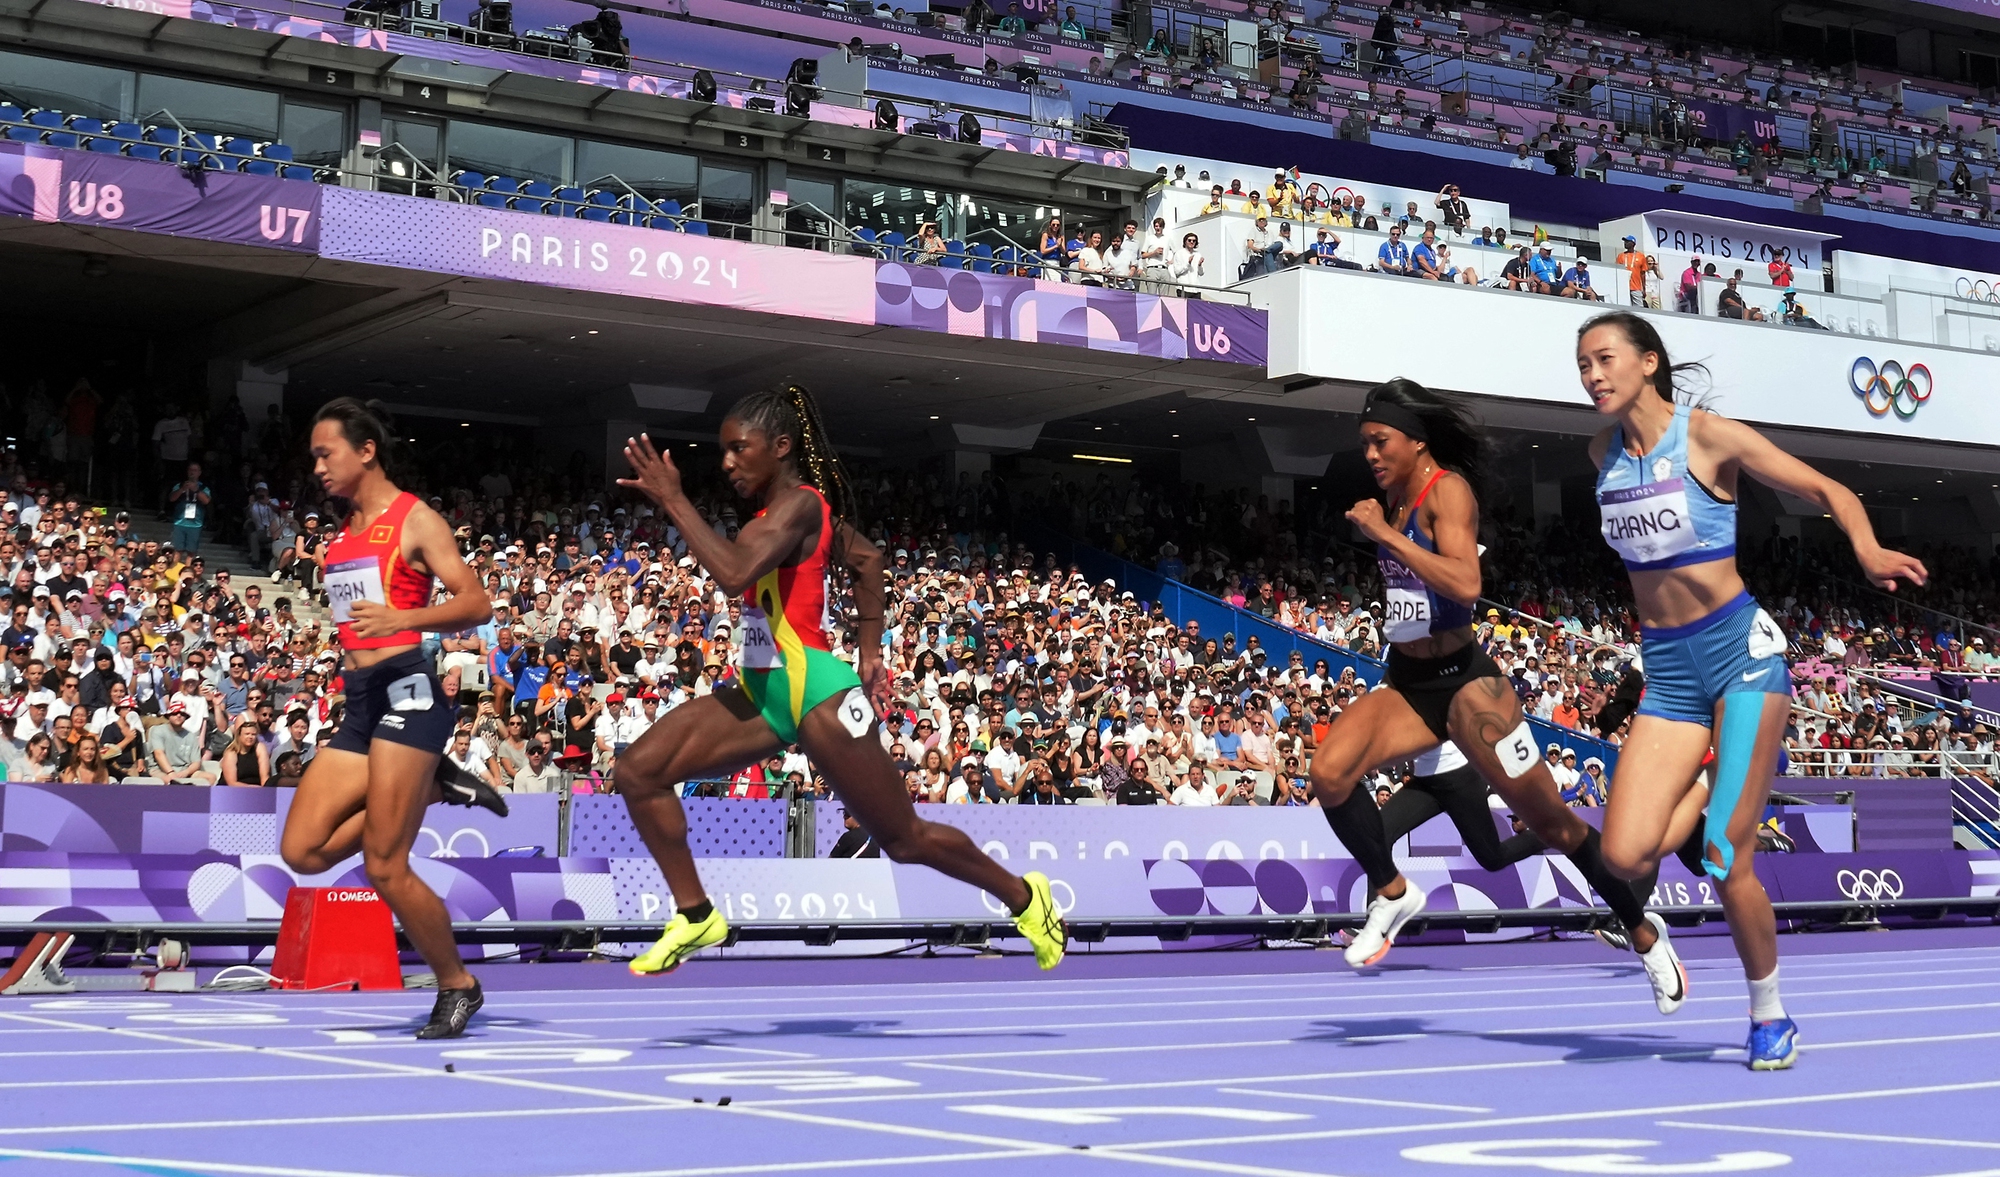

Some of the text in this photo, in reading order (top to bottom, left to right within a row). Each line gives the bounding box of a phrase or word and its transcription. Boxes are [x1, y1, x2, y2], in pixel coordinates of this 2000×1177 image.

[844, 15, 862, 24] 2024
[904, 26, 921, 34] 2024
[327, 72, 336, 84] 5
[921, 68, 939, 77] 2024
[982, 79, 1000, 87] 2024
[420, 86, 431, 100] 4
[1754, 120, 1776, 139] U11
[740, 135, 748, 147] 3
[823, 149, 831, 160] 2
[68, 181, 125, 219] U8
[260, 205, 311, 244] U7
[1743, 240, 1809, 269] 2024
[629, 247, 738, 288] 2024
[1194, 322, 1230, 354] U6
[1607, 508, 1680, 540] ZHANG
[1758, 621, 1774, 642] 4
[404, 683, 416, 699] 7
[849, 704, 863, 723] 6
[1513, 739, 1529, 761] 5
[339, 891, 379, 902] OMEGA
[775, 892, 876, 919] 2024
[1399, 1138, 1793, 1175] 3
